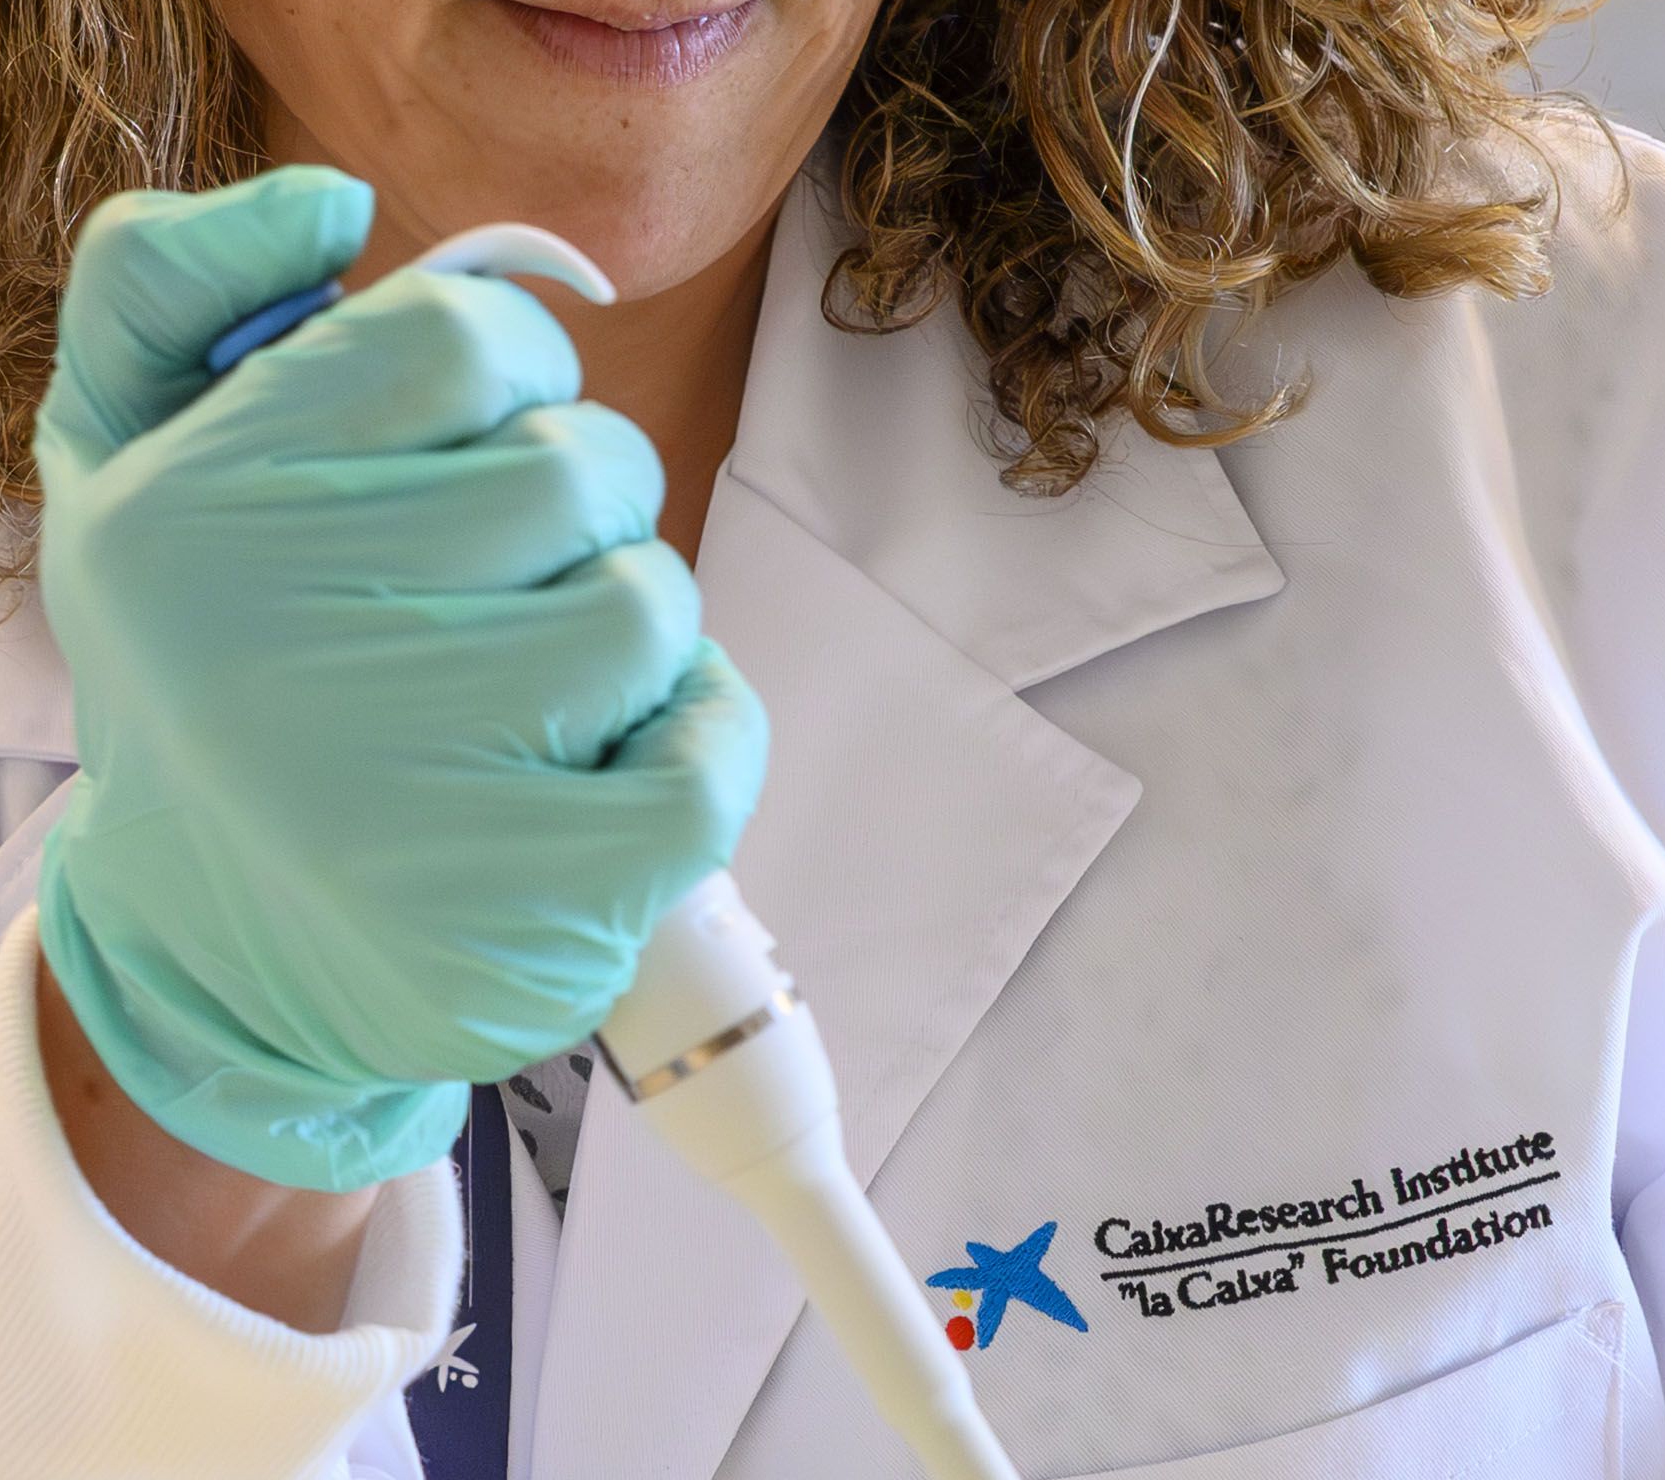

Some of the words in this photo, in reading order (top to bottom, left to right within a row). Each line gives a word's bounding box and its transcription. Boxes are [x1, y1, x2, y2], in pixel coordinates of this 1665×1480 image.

[1094, 1179, 1385, 1259] CaixaResearch
[1391, 1131, 1557, 1205] Institute
[1118, 1278, 1176, 1318] "la
[1177, 1251, 1305, 1310] Caixa"
[1322, 1202, 1554, 1284] Foundation
